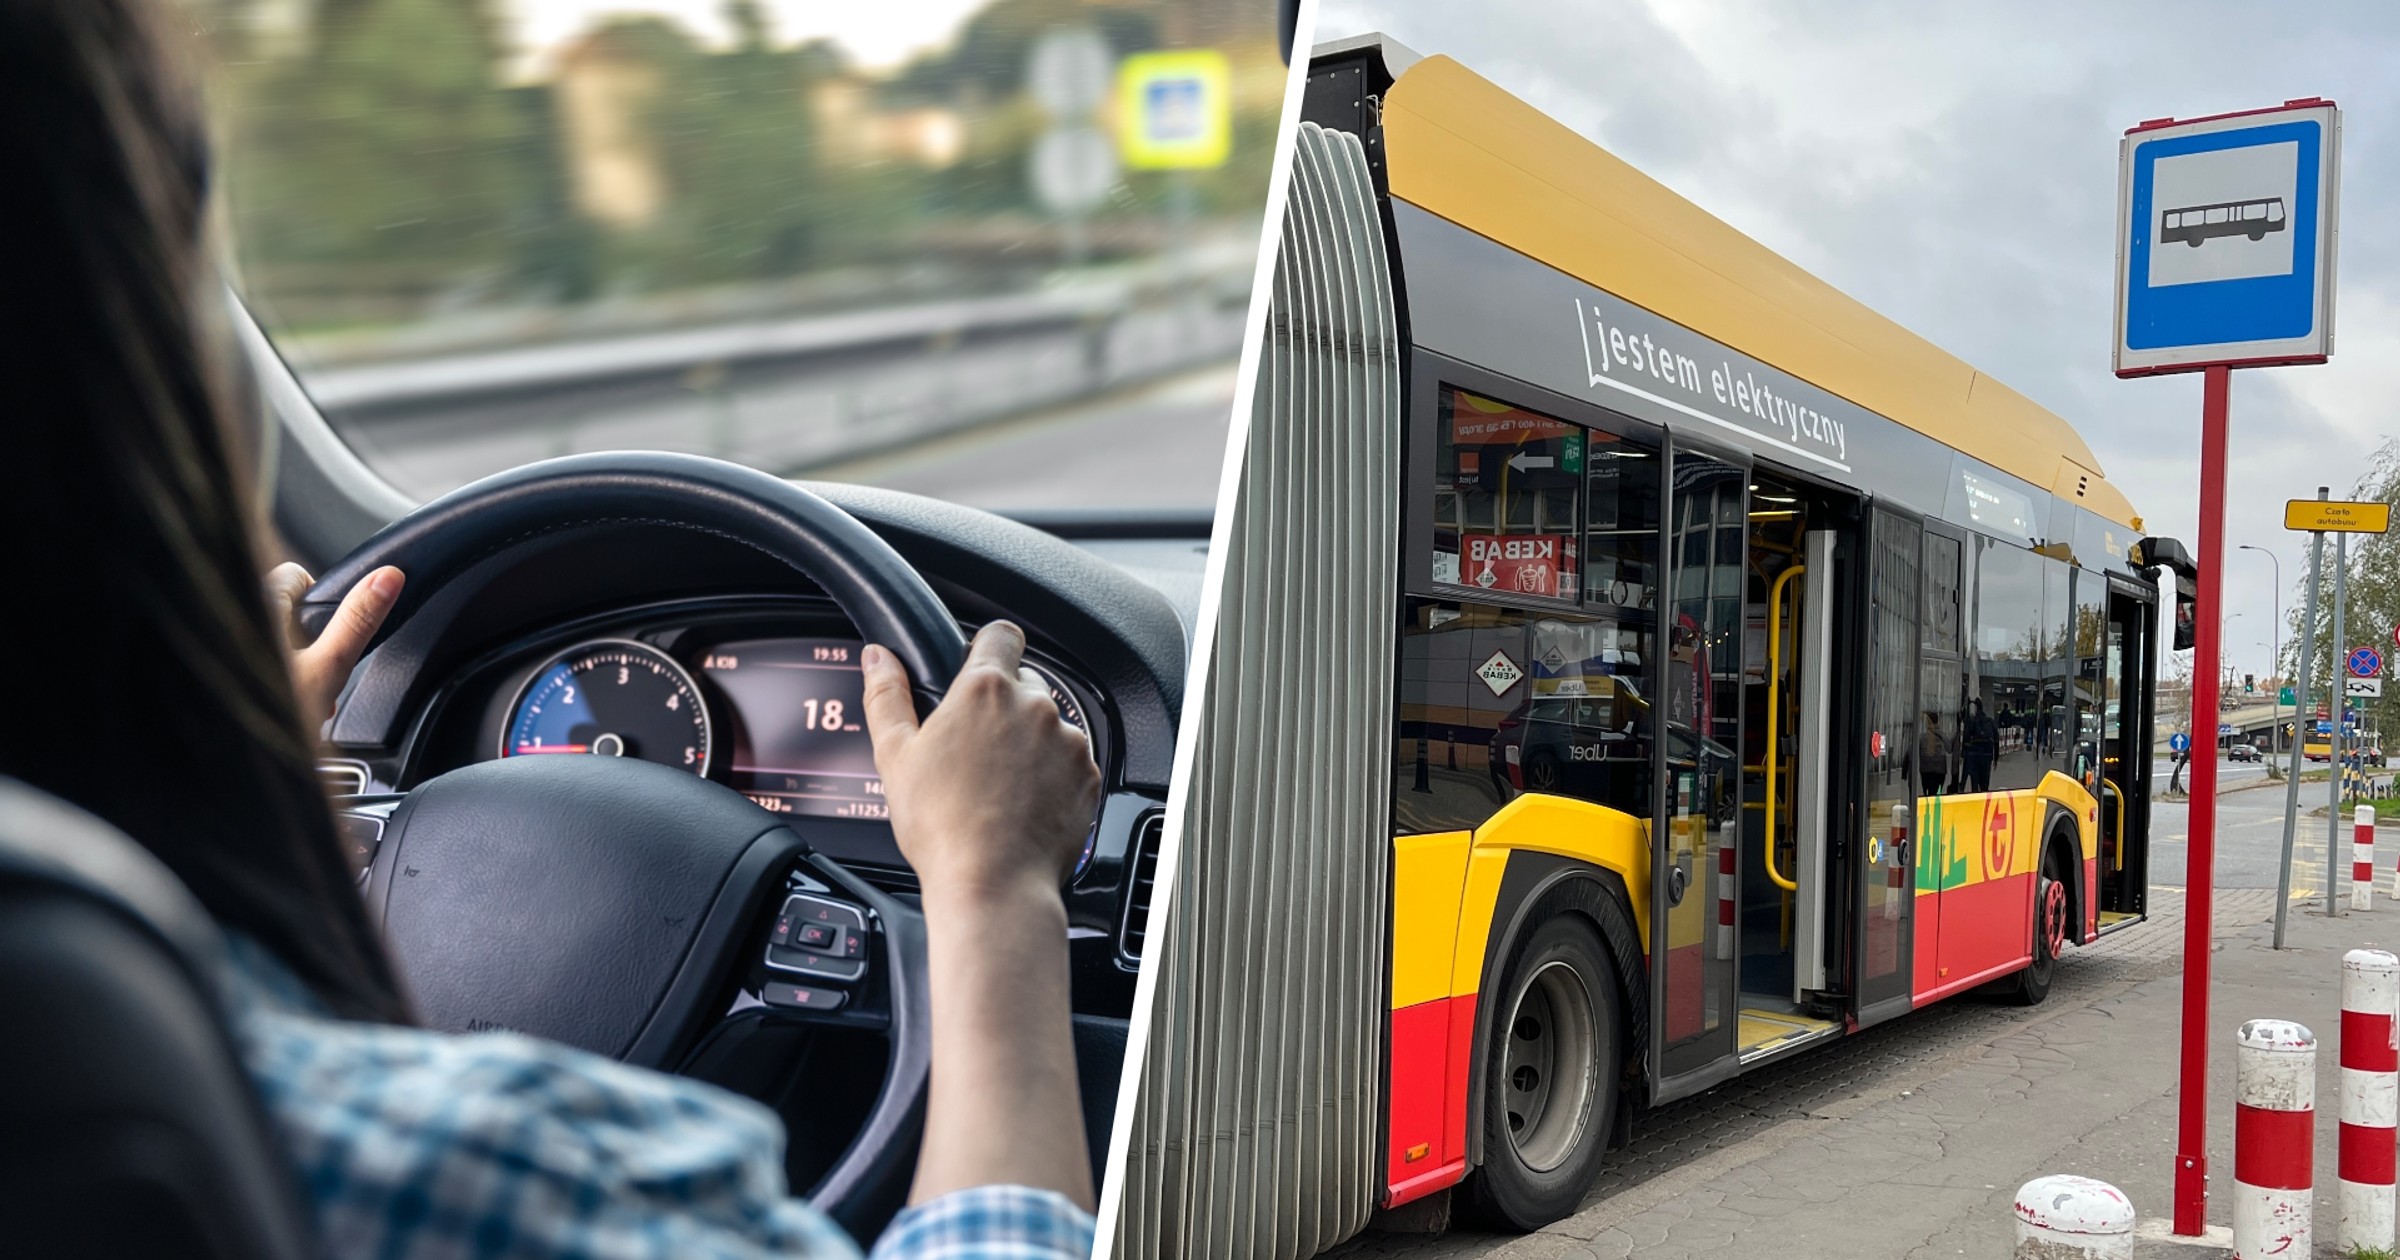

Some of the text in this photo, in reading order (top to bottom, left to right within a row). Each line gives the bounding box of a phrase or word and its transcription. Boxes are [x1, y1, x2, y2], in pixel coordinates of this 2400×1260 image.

[1594, 306, 1846, 460] jestem elektryczny
[2316, 518, 2357, 526] autobusu
[813, 648, 848, 662] 19:55
[617, 667, 629, 685] 3
[562, 686, 575, 704] 2
[666, 694, 679, 711] 4
[803, 699, 844, 731] 18
[533, 736, 542, 749] 1
[684, 746, 696, 765] 5
[807, 928, 824, 940] OK
